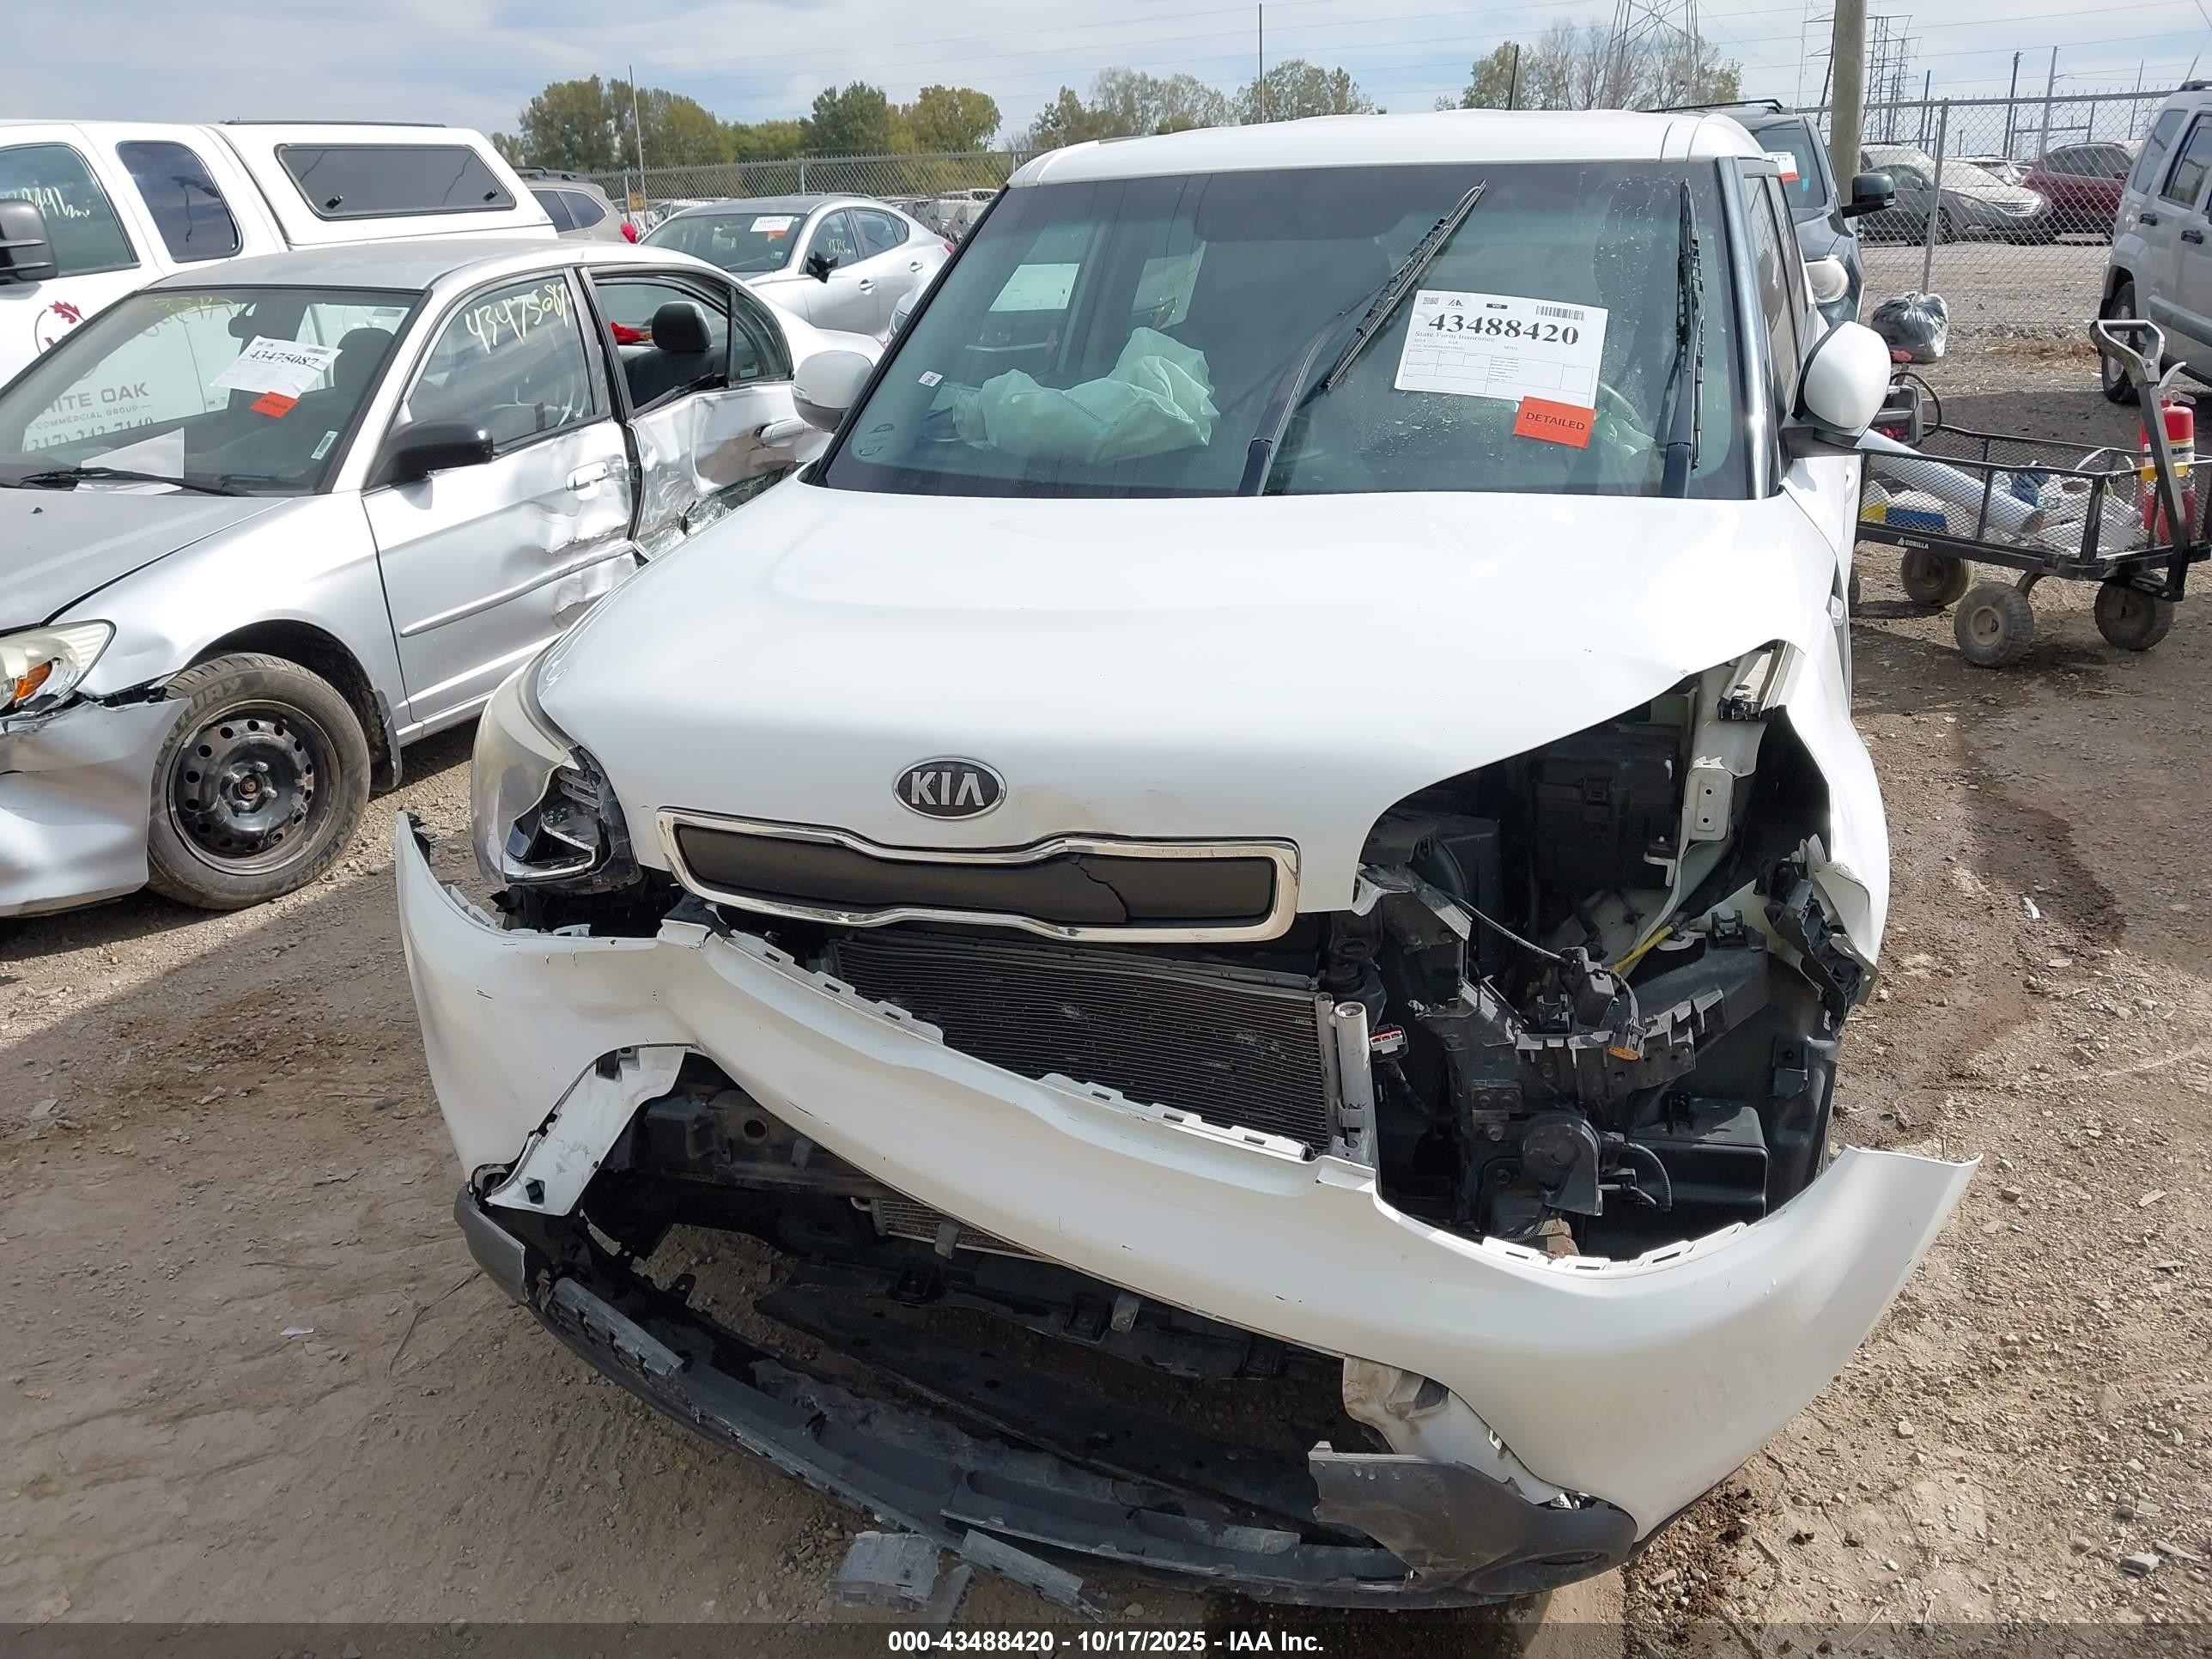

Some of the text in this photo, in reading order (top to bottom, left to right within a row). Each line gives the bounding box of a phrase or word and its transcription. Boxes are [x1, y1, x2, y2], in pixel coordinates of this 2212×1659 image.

[1428, 313, 1579, 345] 43488420
[1458, 334, 1496, 343] Insurance
[249, 349, 320, 366] 43475087
[45, 382, 150, 415] ITE OAK
[36, 404, 139, 429] COMMERCIAL GROUP
[1525, 412, 1586, 430] DETAILED
[1905, 539, 1929, 550] GORILLA
[911, 771, 986, 806] KIA
